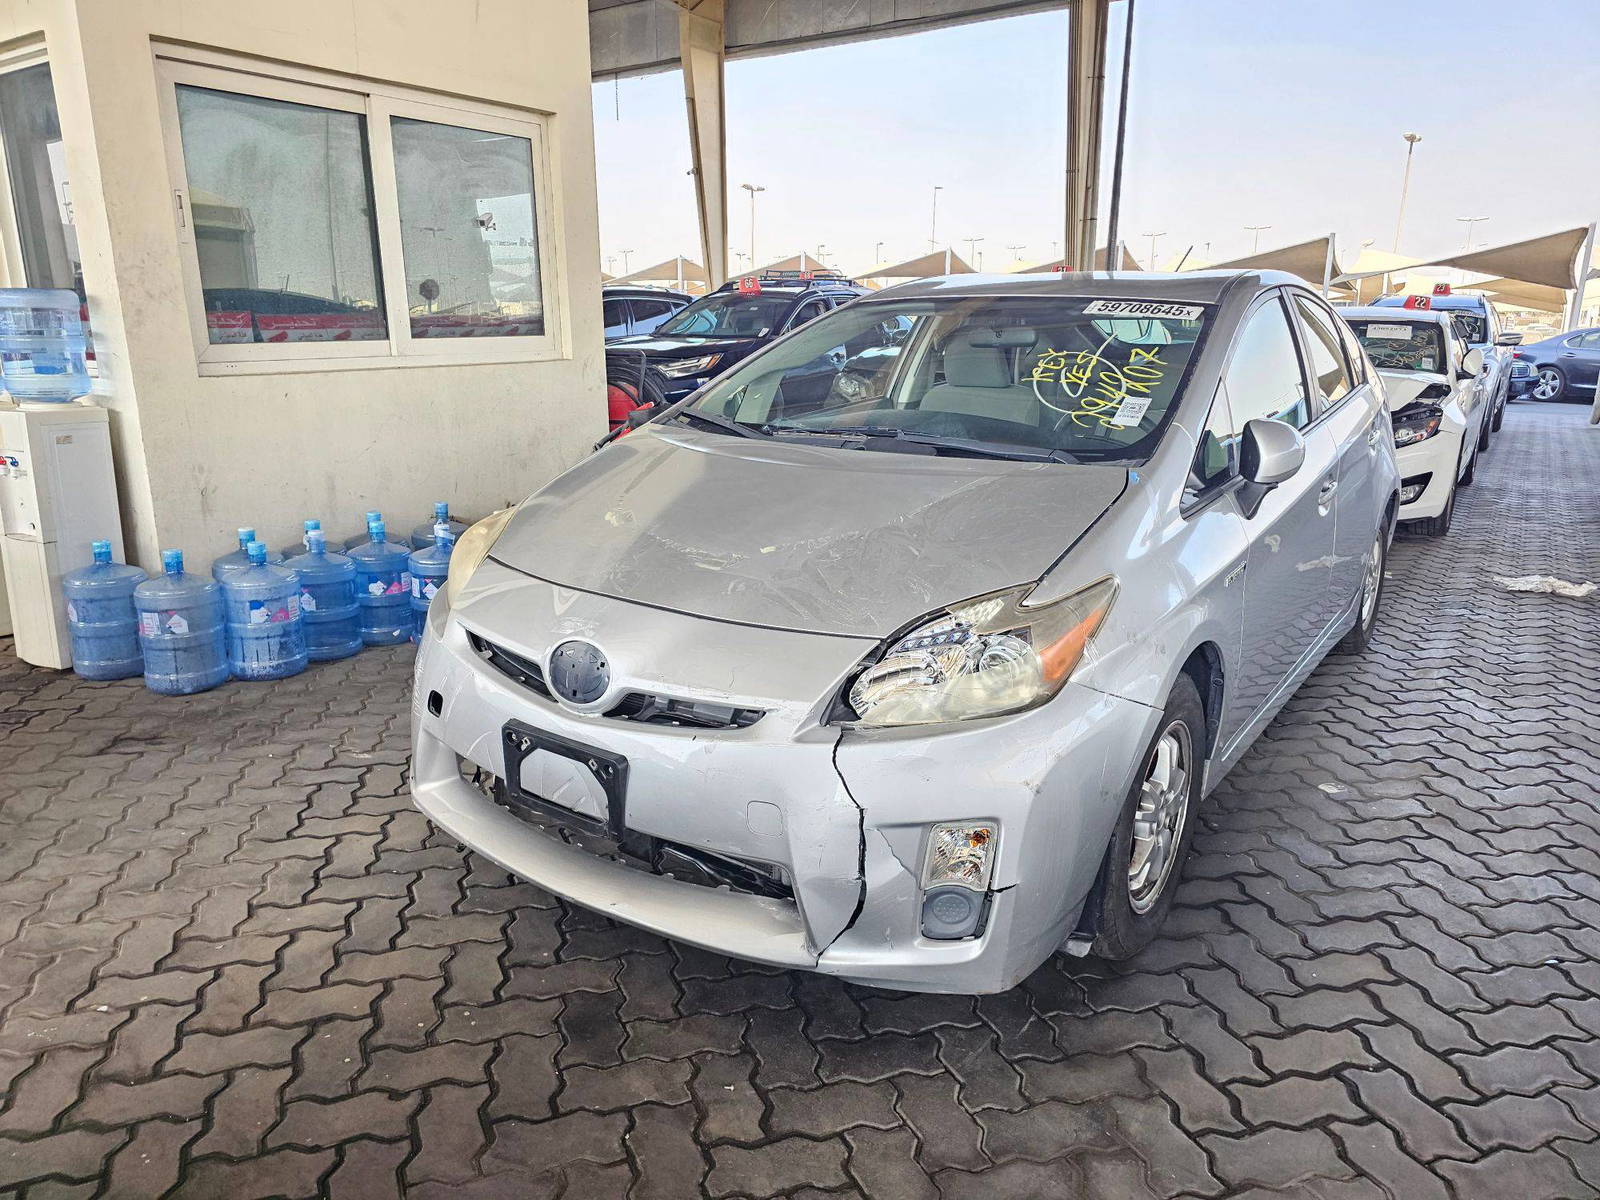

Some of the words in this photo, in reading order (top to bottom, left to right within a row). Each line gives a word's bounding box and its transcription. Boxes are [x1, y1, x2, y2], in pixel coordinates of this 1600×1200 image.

[1414, 296, 1427, 309] 22
[1021, 347, 1067, 382] KEY
[1059, 349, 1097, 387] YES
